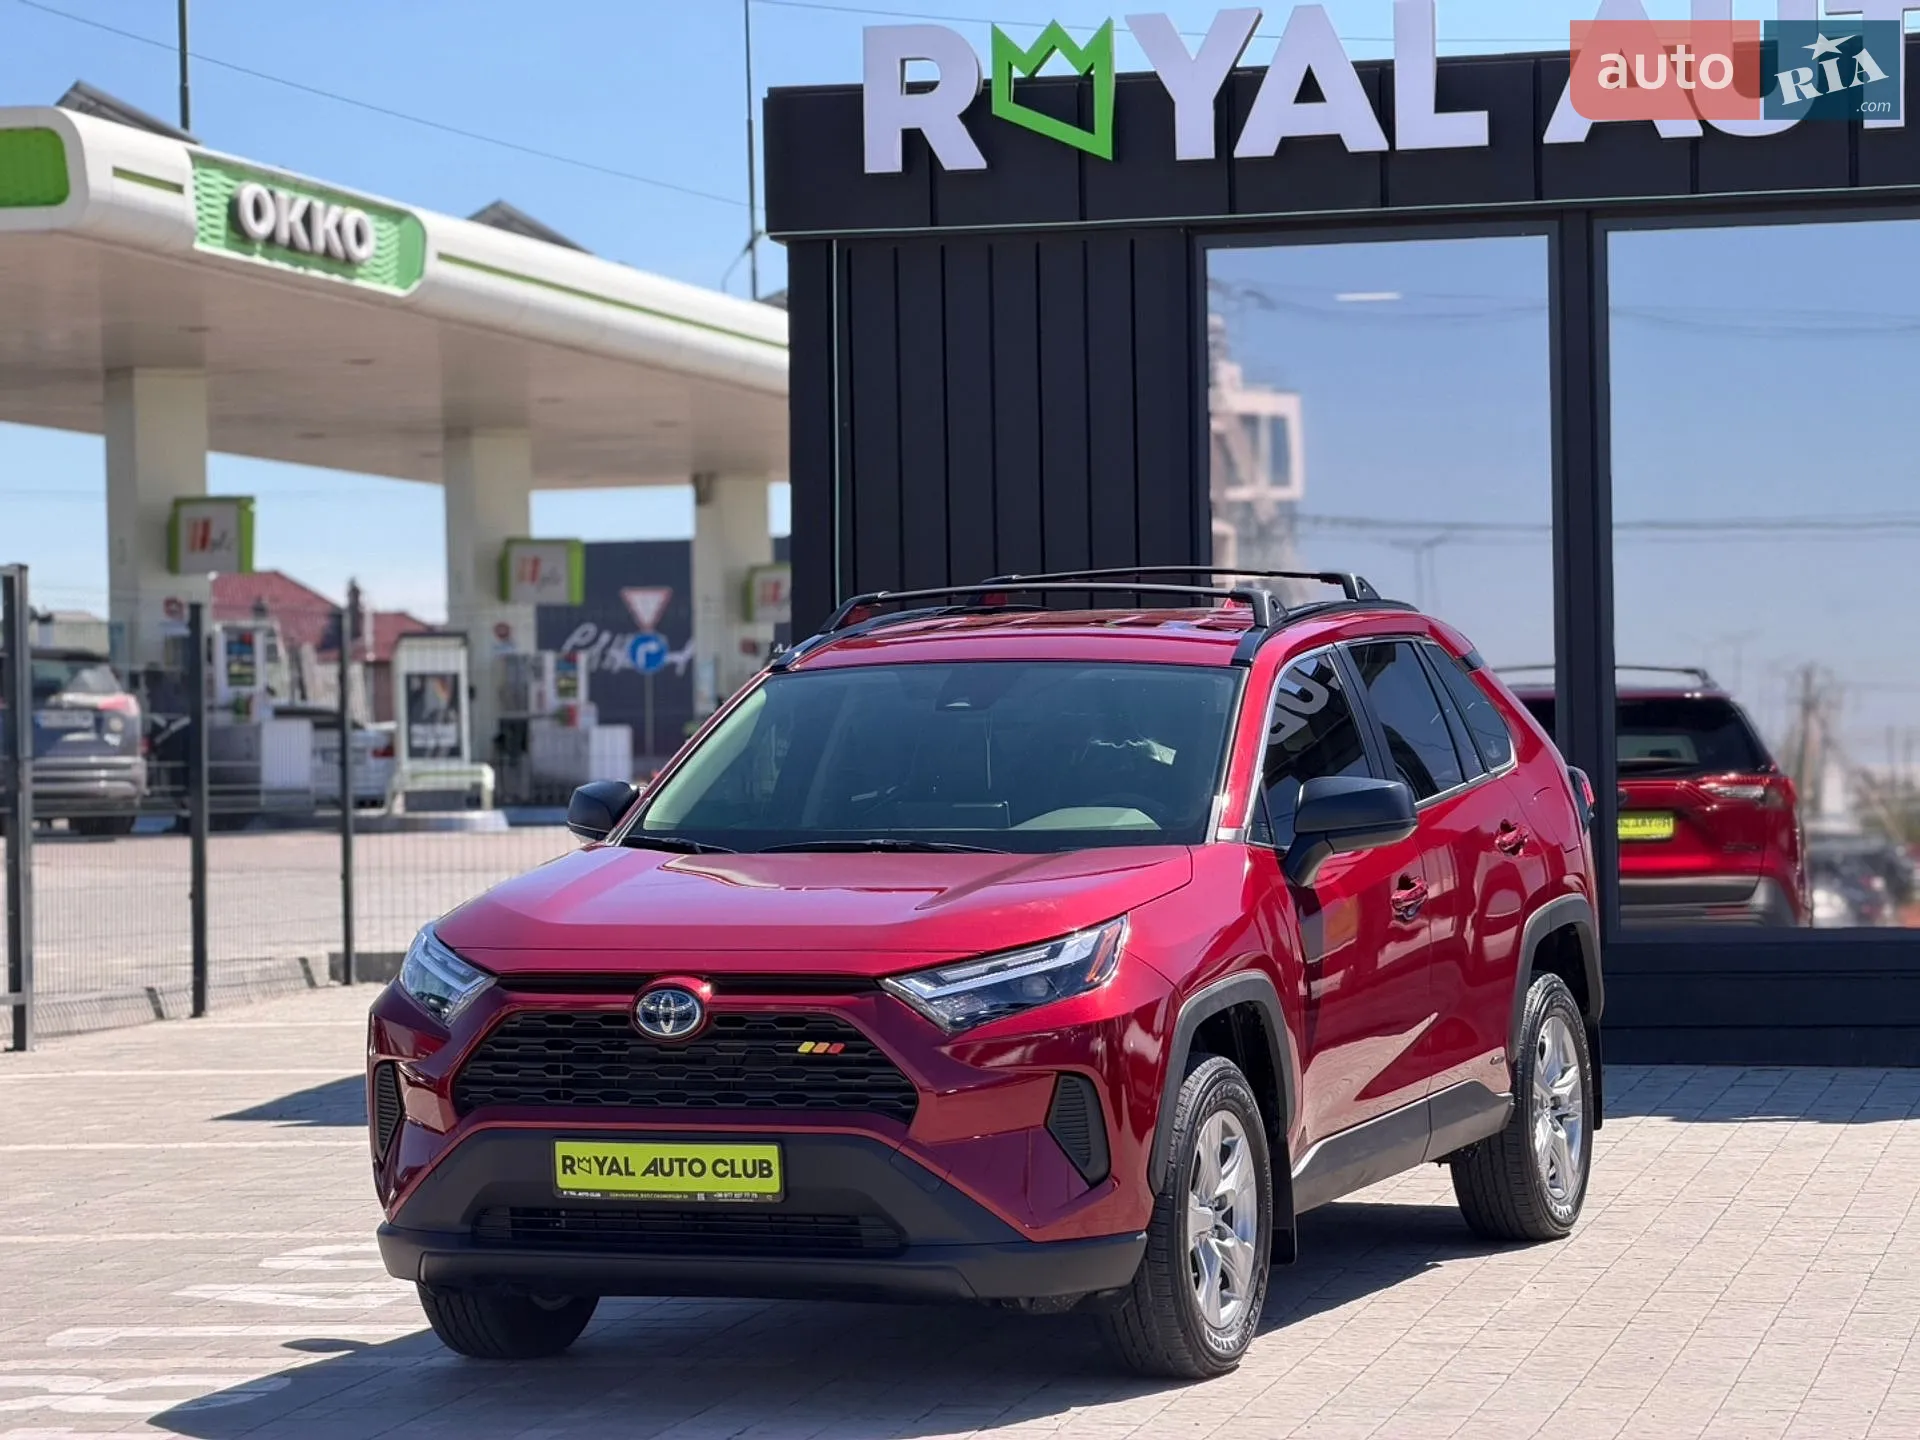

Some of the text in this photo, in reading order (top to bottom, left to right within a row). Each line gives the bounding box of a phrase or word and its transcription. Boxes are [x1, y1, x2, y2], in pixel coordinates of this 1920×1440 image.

[238, 183, 375, 262] OKKO
[641, 1157, 706, 1178] AUTO
[712, 1158, 774, 1179] CLUB
